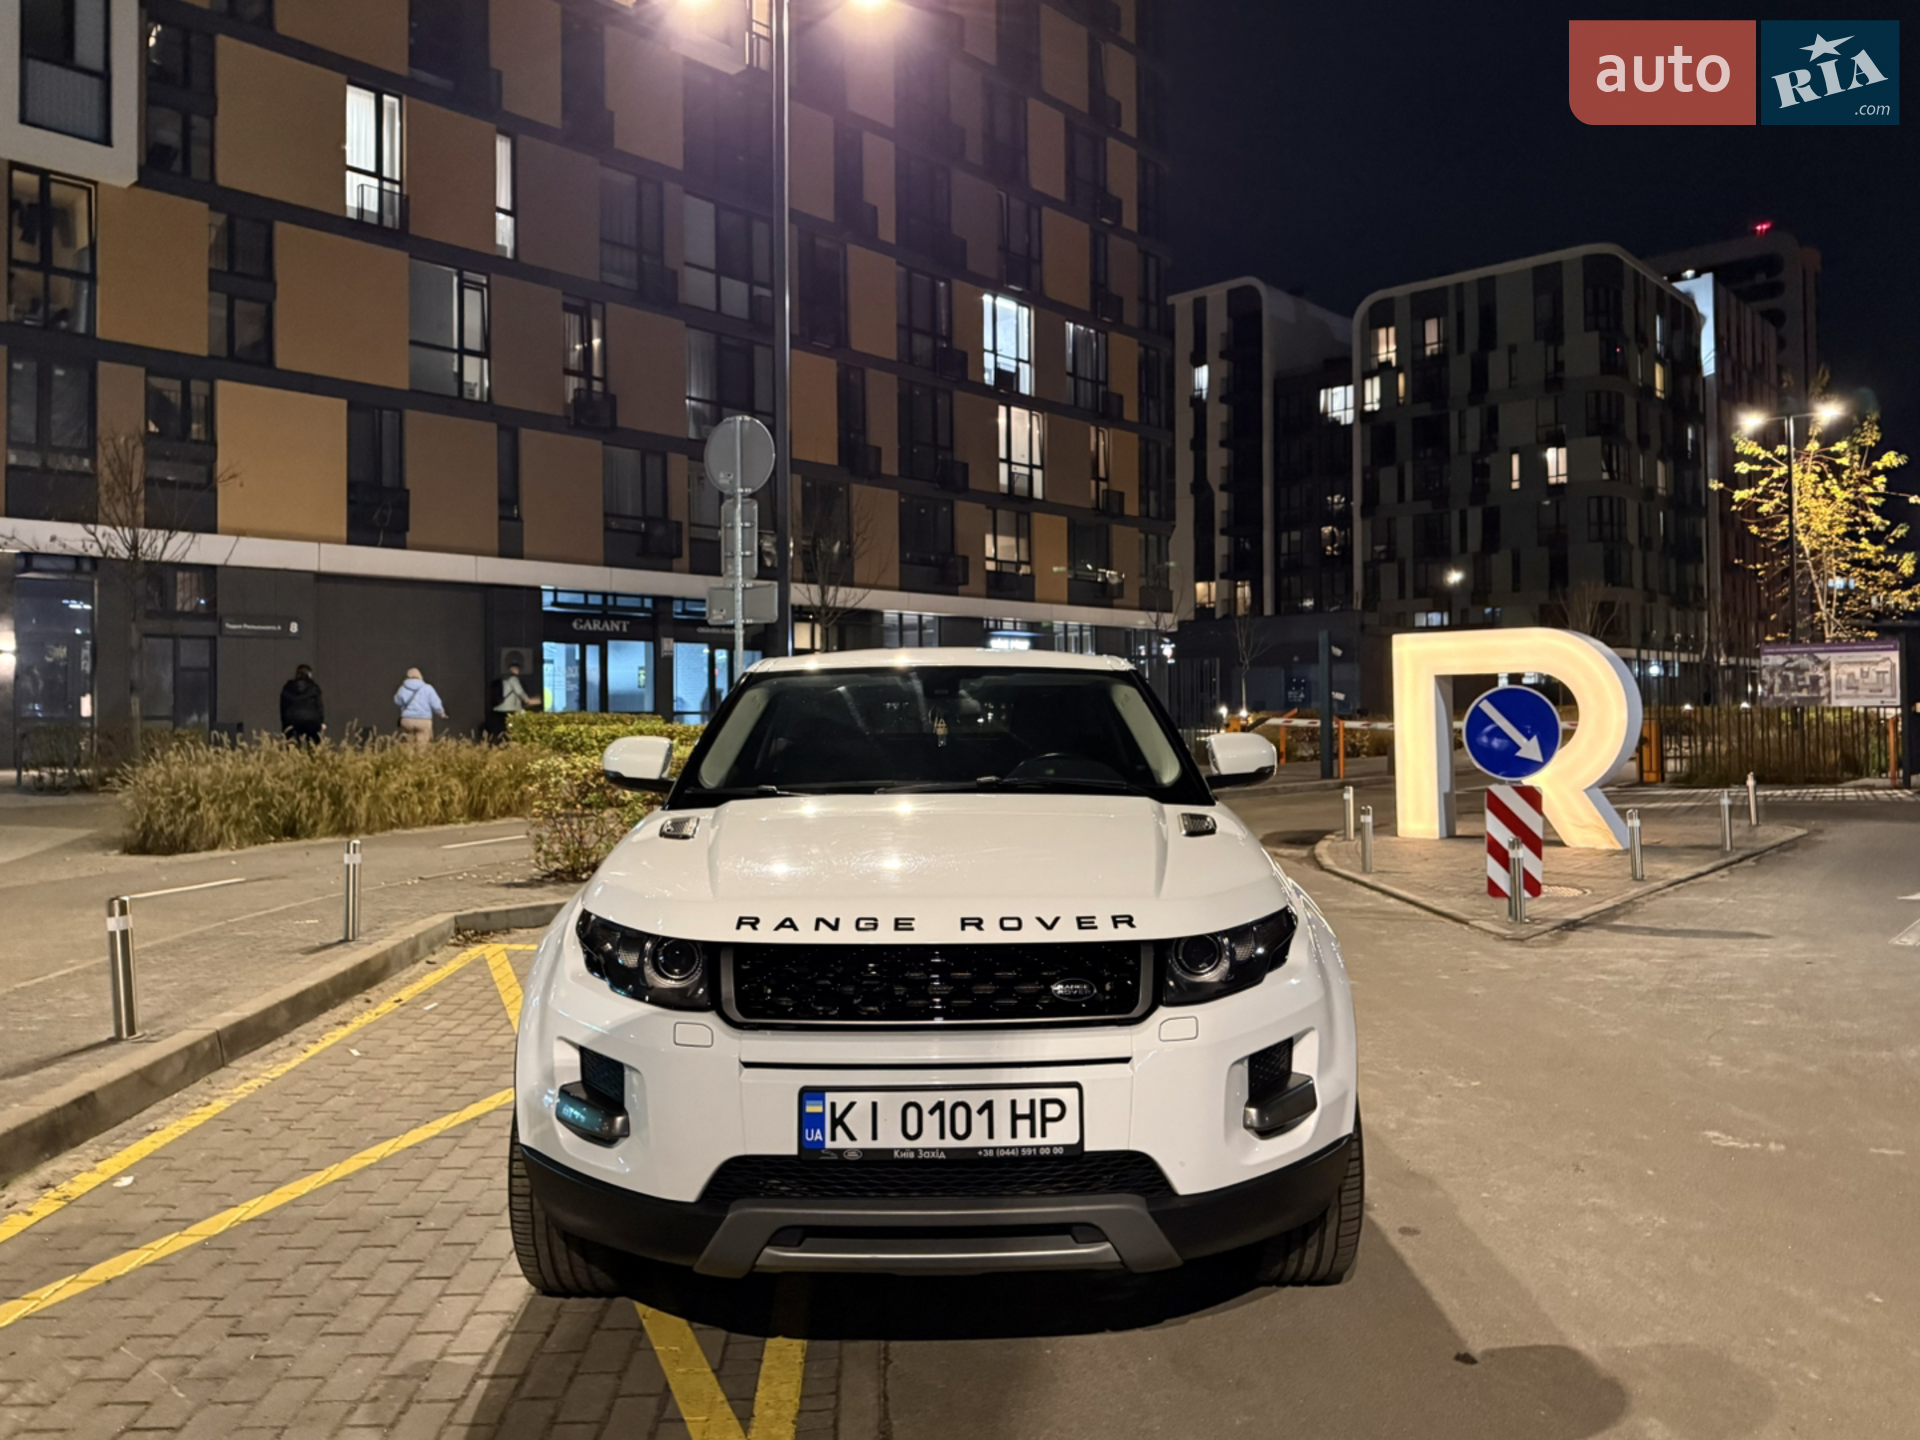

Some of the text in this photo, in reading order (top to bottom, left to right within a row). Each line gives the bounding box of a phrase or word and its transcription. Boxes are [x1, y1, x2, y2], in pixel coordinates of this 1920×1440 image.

[289, 621, 298, 633] 8
[571, 618, 630, 633] GARANT
[735, 914, 1137, 932] RANGE ROVER
[829, 1098, 1067, 1142] KI 0101 HP
[805, 1128, 823, 1142] UA
[893, 1149, 947, 1159] Київ Захід
[977, 1146, 1064, 1157] +38 (044) 591 00 00
